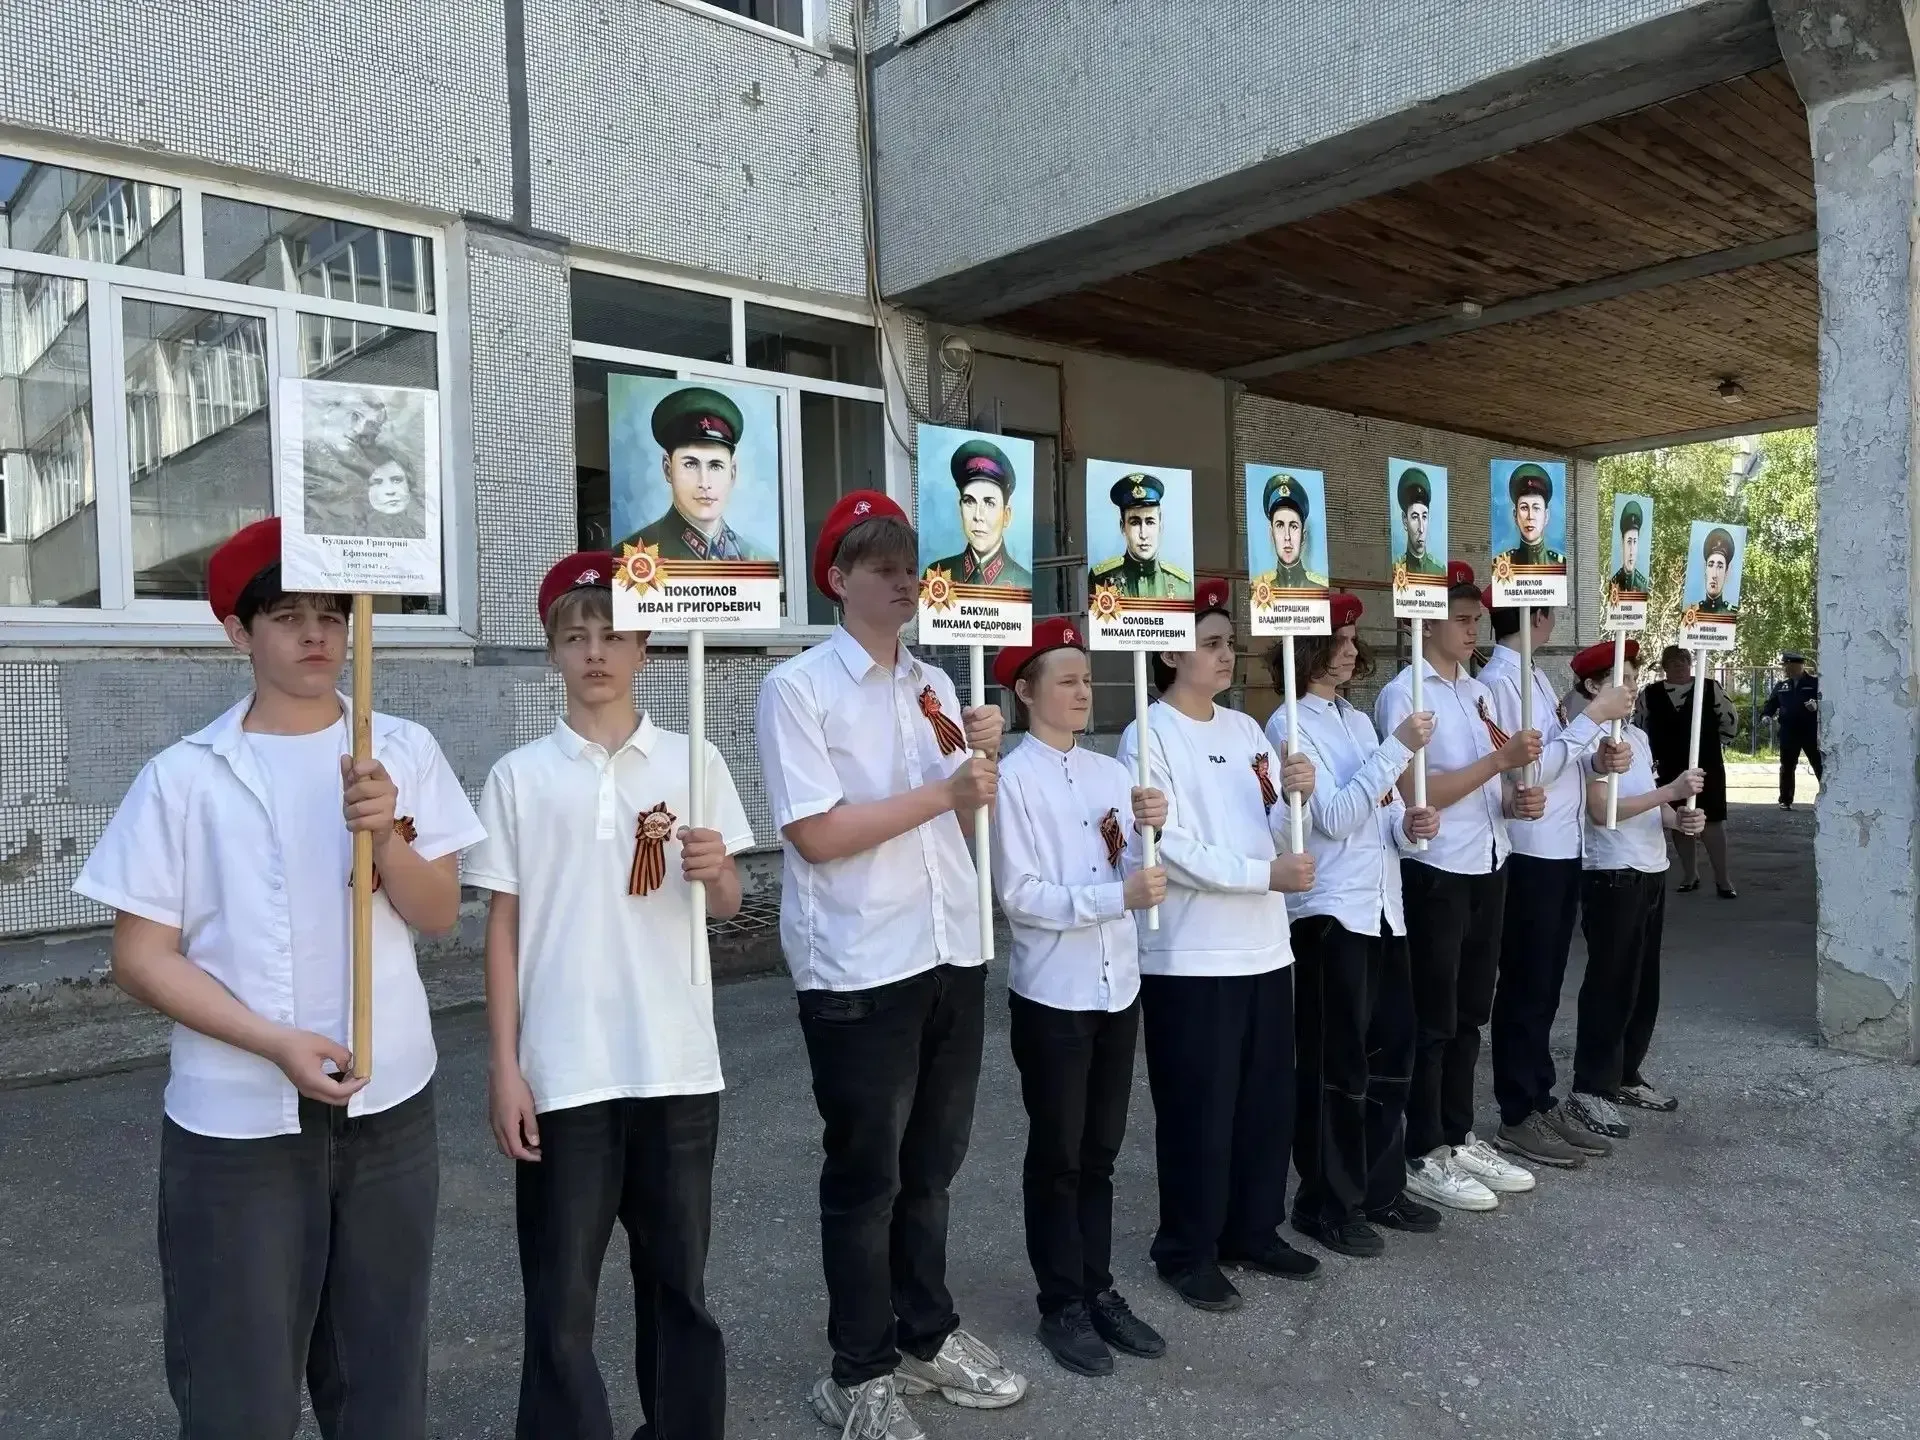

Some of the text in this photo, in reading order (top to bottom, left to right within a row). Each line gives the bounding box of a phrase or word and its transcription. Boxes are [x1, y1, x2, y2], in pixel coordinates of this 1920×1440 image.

[343, 549, 388, 558] Ефимович
[664, 586, 737, 596] ПОКОТИЛОВ
[638, 602, 761, 613] ИВАН ГРИГОРЬЕВИЧ
[960, 606, 999, 616] БАКУЛИН
[933, 619, 1022, 631] МИХАИЛ ФЕДОРОВИЧ
[1123, 617, 1164, 625] СОЛОВЬЕВ
[1259, 616, 1292, 624] ВЛАДИМИР
[1101, 628, 1186, 638] МИХАИЛ ГЕОРГИЕВИЧ
